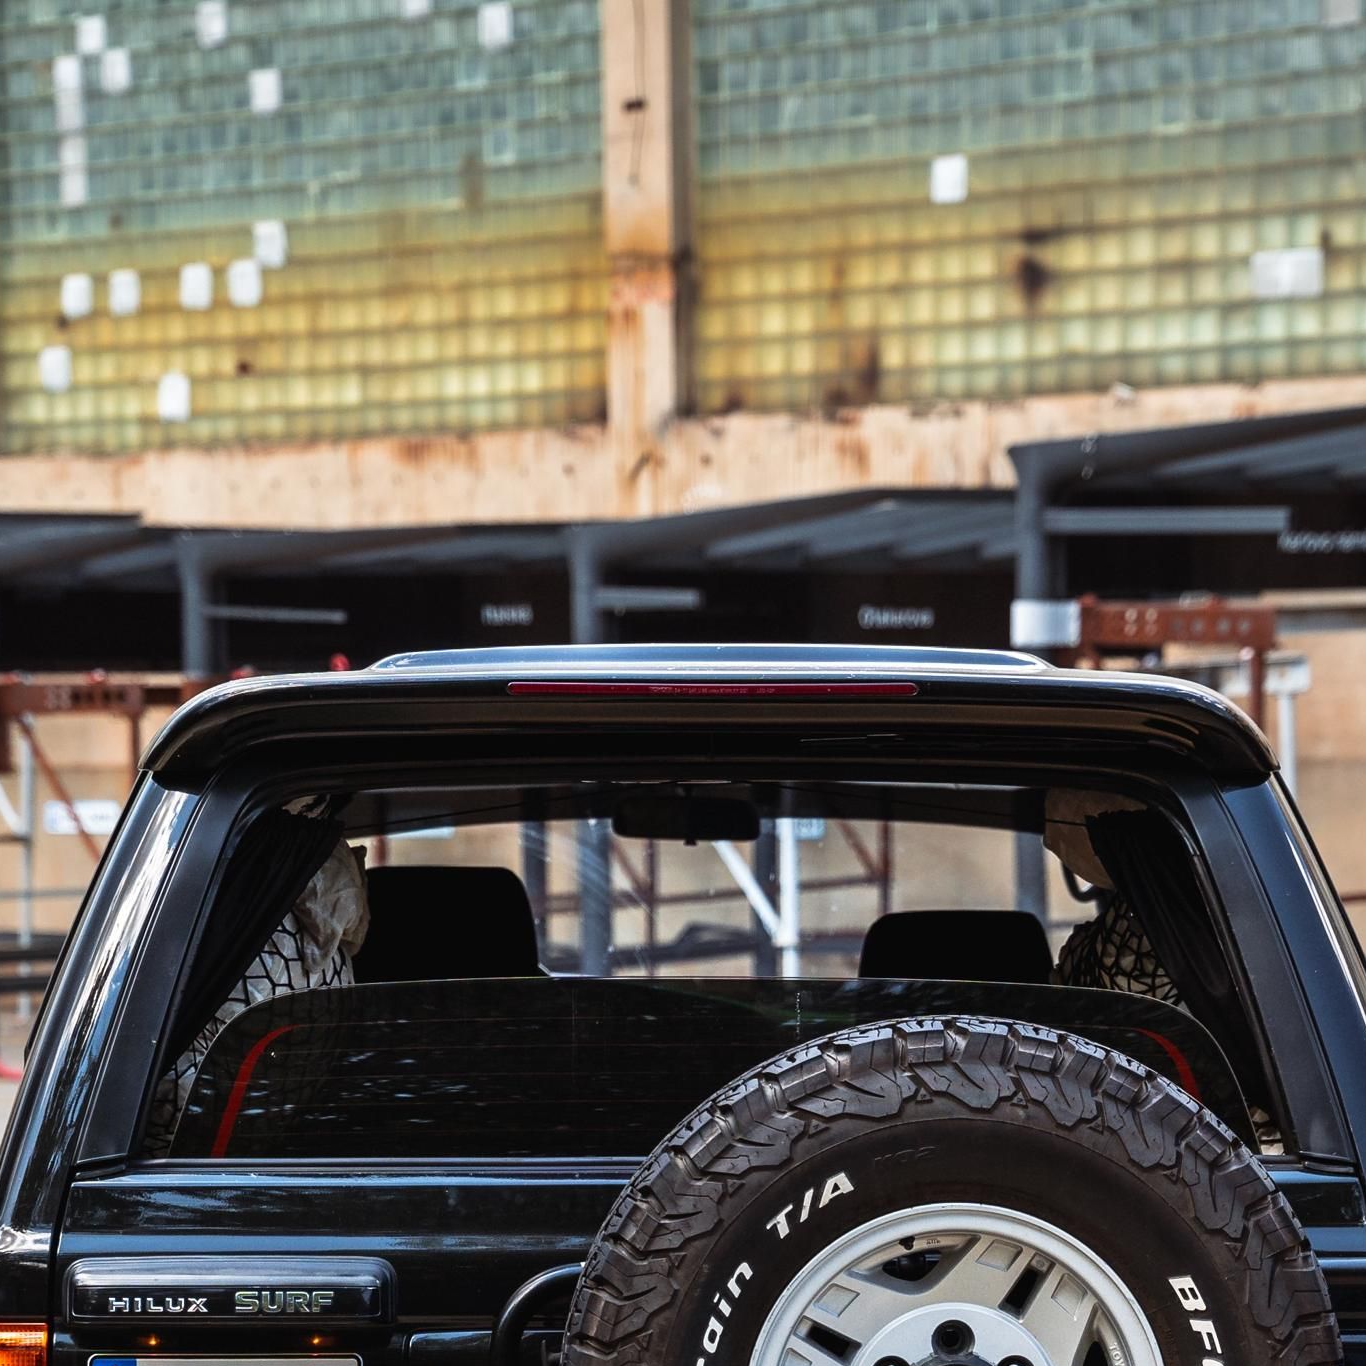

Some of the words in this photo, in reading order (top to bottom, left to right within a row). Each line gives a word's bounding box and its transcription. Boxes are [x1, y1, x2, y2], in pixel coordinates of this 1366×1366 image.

[766, 1172, 855, 1240] T/A
[108, 1297, 208, 1313] HILUX
[234, 1290, 335, 1313] SURF
